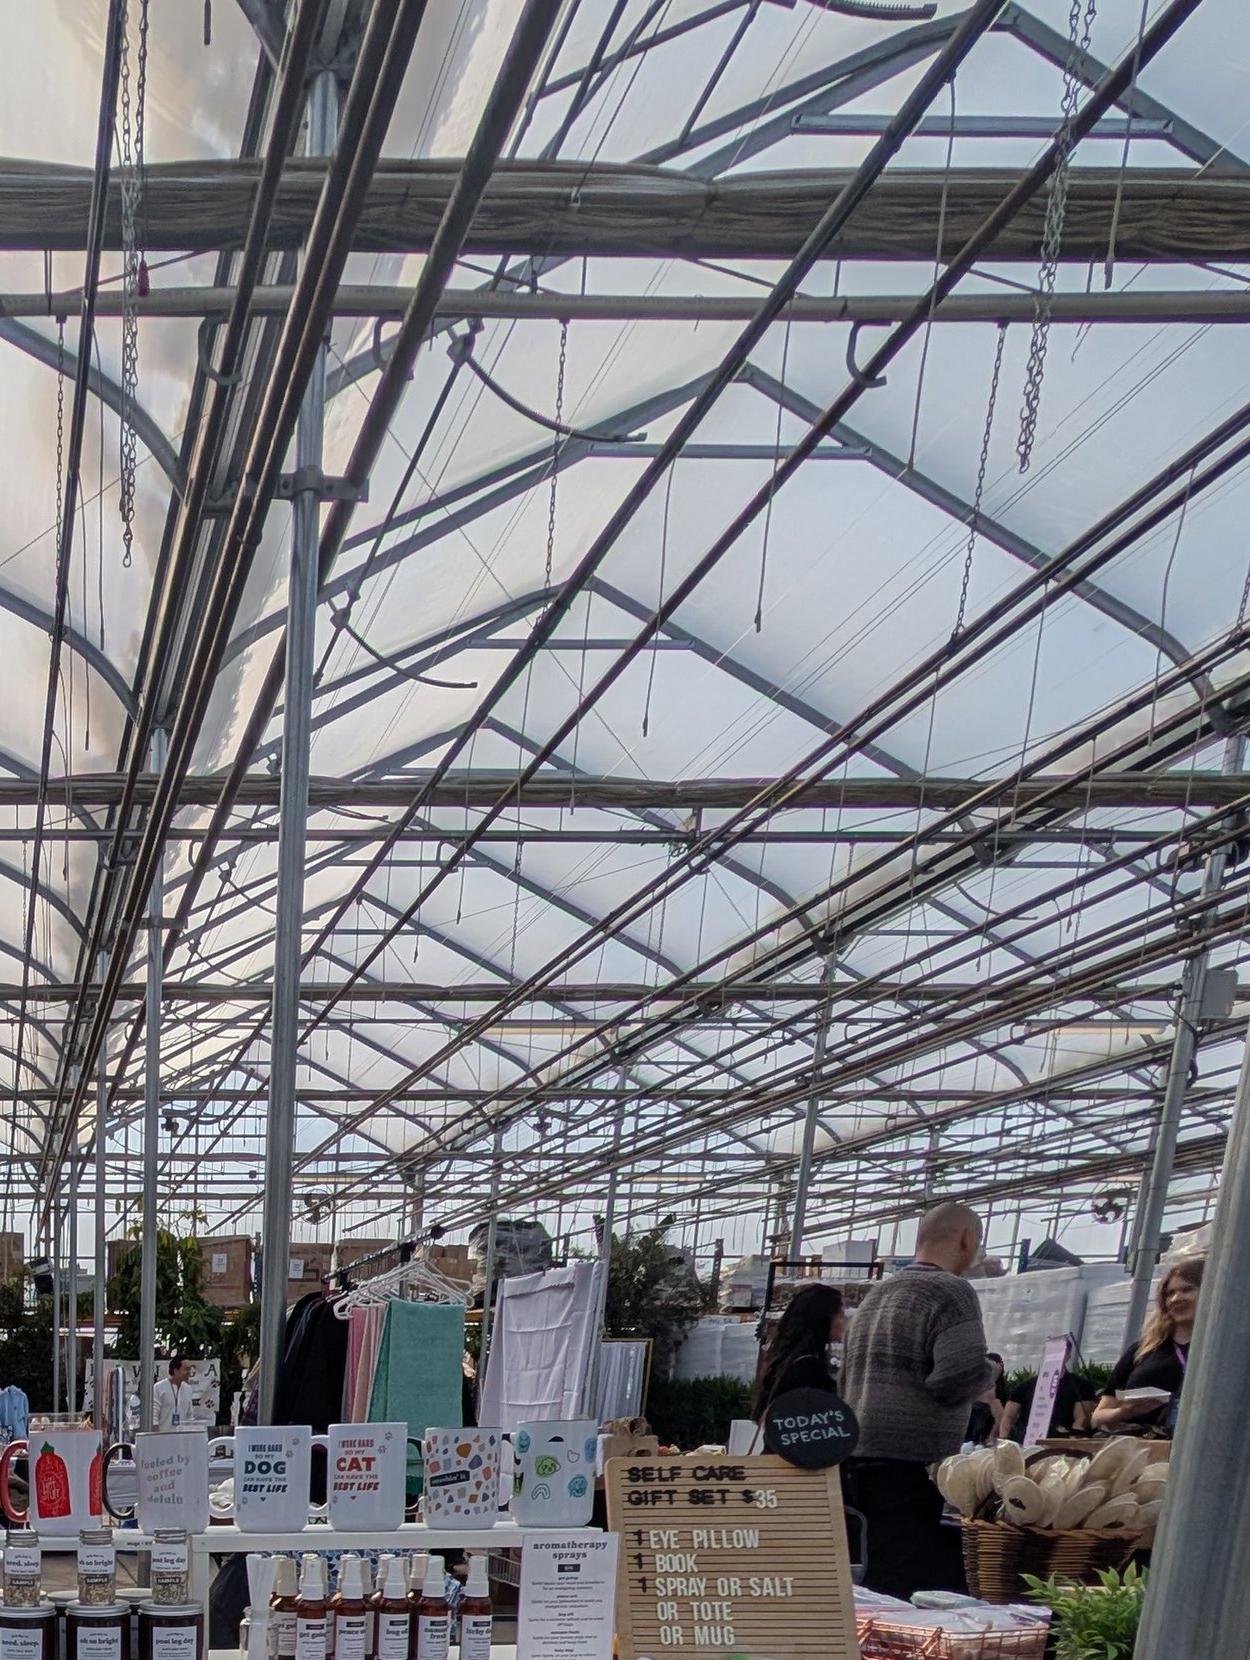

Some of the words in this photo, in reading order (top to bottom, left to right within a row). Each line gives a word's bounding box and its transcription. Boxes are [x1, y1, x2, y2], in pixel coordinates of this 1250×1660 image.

[773, 1410, 846, 1431] TODAY'S
[780, 1427, 851, 1446] SPECIAL
[244, 1461, 286, 1475] DOG
[336, 1457, 377, 1472] CAT
[146, 1467, 183, 1482] coffee
[627, 1466, 682, 1483] SELF
[691, 1465, 747, 1481] CARE
[153, 1482, 175, 1492] and
[243, 1484, 265, 1493] BEST
[266, 1484, 288, 1493] LIFE
[333, 1482, 357, 1491] BEST
[357, 1482, 380, 1491] LIFE
[627, 1489, 677, 1506] GIFT
[688, 1489, 730, 1505] SET
[741, 1488, 778, 1509] $35
[533, 1540, 608, 1551] aromatherapy
[633, 1530, 644, 1546] 1
[650, 1531, 679, 1549] EYE
[693, 1530, 760, 1549] PILLOW
[552, 1551, 587, 1561] sprays
[633, 1553, 644, 1569] 1
[655, 1554, 698, 1574] BOOK
[638, 1577, 648, 1593] 1
[655, 1577, 707, 1597] SPRAY
[717, 1578, 742, 1597] OR
[749, 1577, 794, 1597] SALT
[657, 1602, 679, 1621] OR
[690, 1602, 734, 1621] TOTE
[660, 1627, 684, 1646] OR
[694, 1626, 735, 1646] MUG
